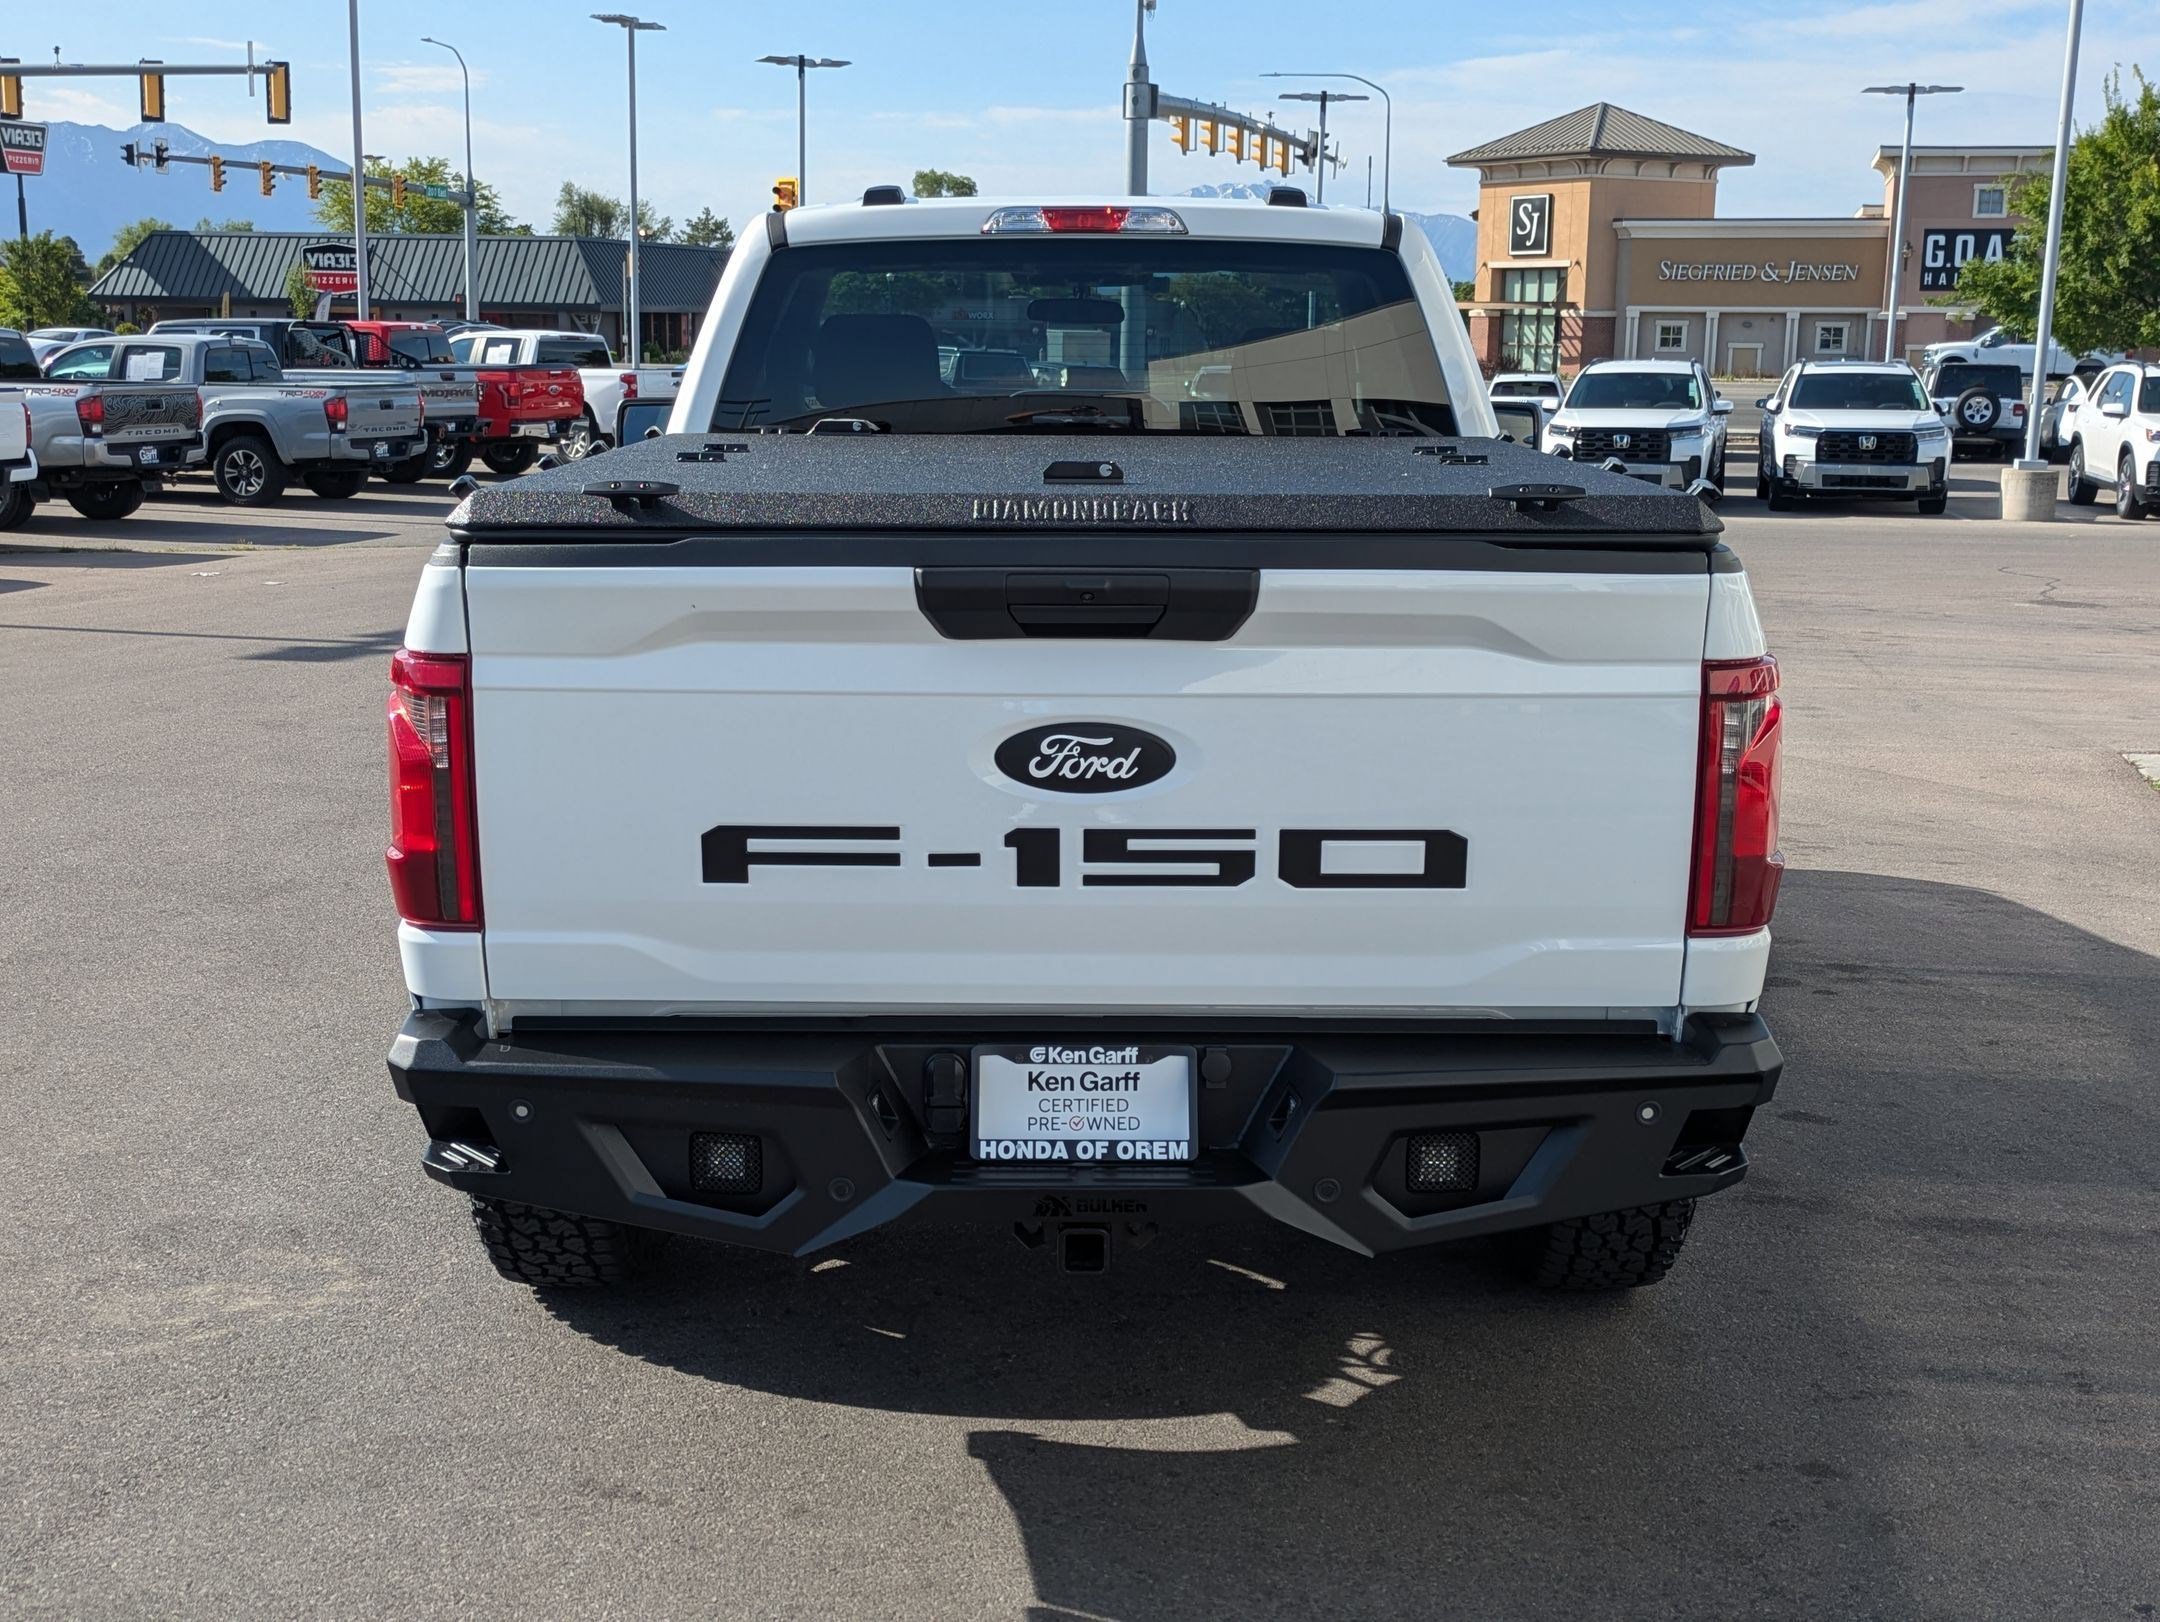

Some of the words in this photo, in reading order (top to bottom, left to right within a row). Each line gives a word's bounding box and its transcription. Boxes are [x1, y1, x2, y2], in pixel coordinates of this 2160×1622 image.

[1, 127, 43, 147] VIA313
[1516, 203, 1540, 246] SJ
[1659, 260, 1756, 280] SIEGFRIED
[1760, 262, 1781, 281] &
[1784, 261, 1859, 283] JENSEN
[421, 388, 474, 398] MOJAVE
[126, 428, 180, 436] TACOMA
[363, 425, 407, 433] TACOMA
[972, 499, 1191, 521] DIAMONDBACK
[1029, 734, 1140, 779] Ford
[701, 824, 1468, 889] F-150
[1049, 1046, 1087, 1064] Ken
[1089, 1046, 1139, 1064] Garff
[1027, 1071, 1075, 1092] Ken
[1080, 1071, 1140, 1092] Garff
[1038, 1098, 1129, 1113] CERTIFIED
[979, 1140, 1069, 1160] HONDA
[1076, 1140, 1109, 1160] OF
[1116, 1140, 1189, 1160] OREM
